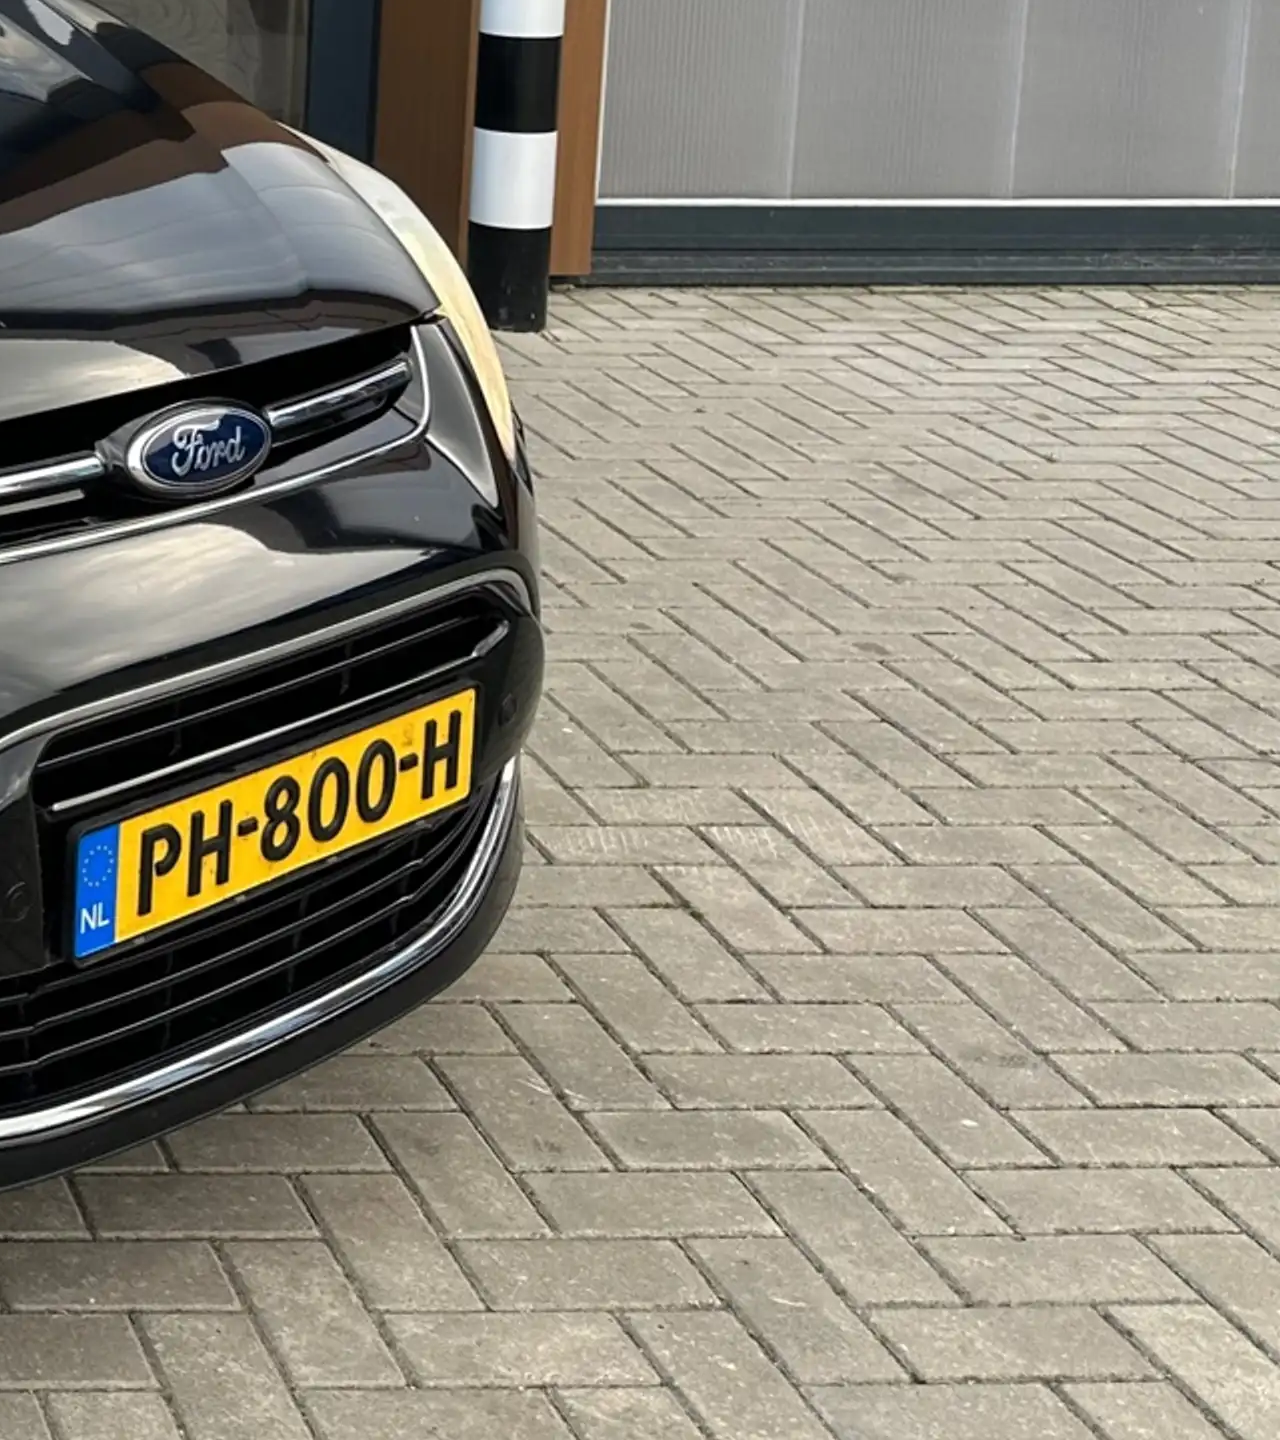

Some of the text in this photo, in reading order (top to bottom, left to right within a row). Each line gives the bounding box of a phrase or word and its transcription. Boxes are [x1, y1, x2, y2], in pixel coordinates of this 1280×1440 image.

[171, 419, 246, 477] Ford
[137, 709, 462, 917] PH-800-H
[79, 901, 110, 934] NL
